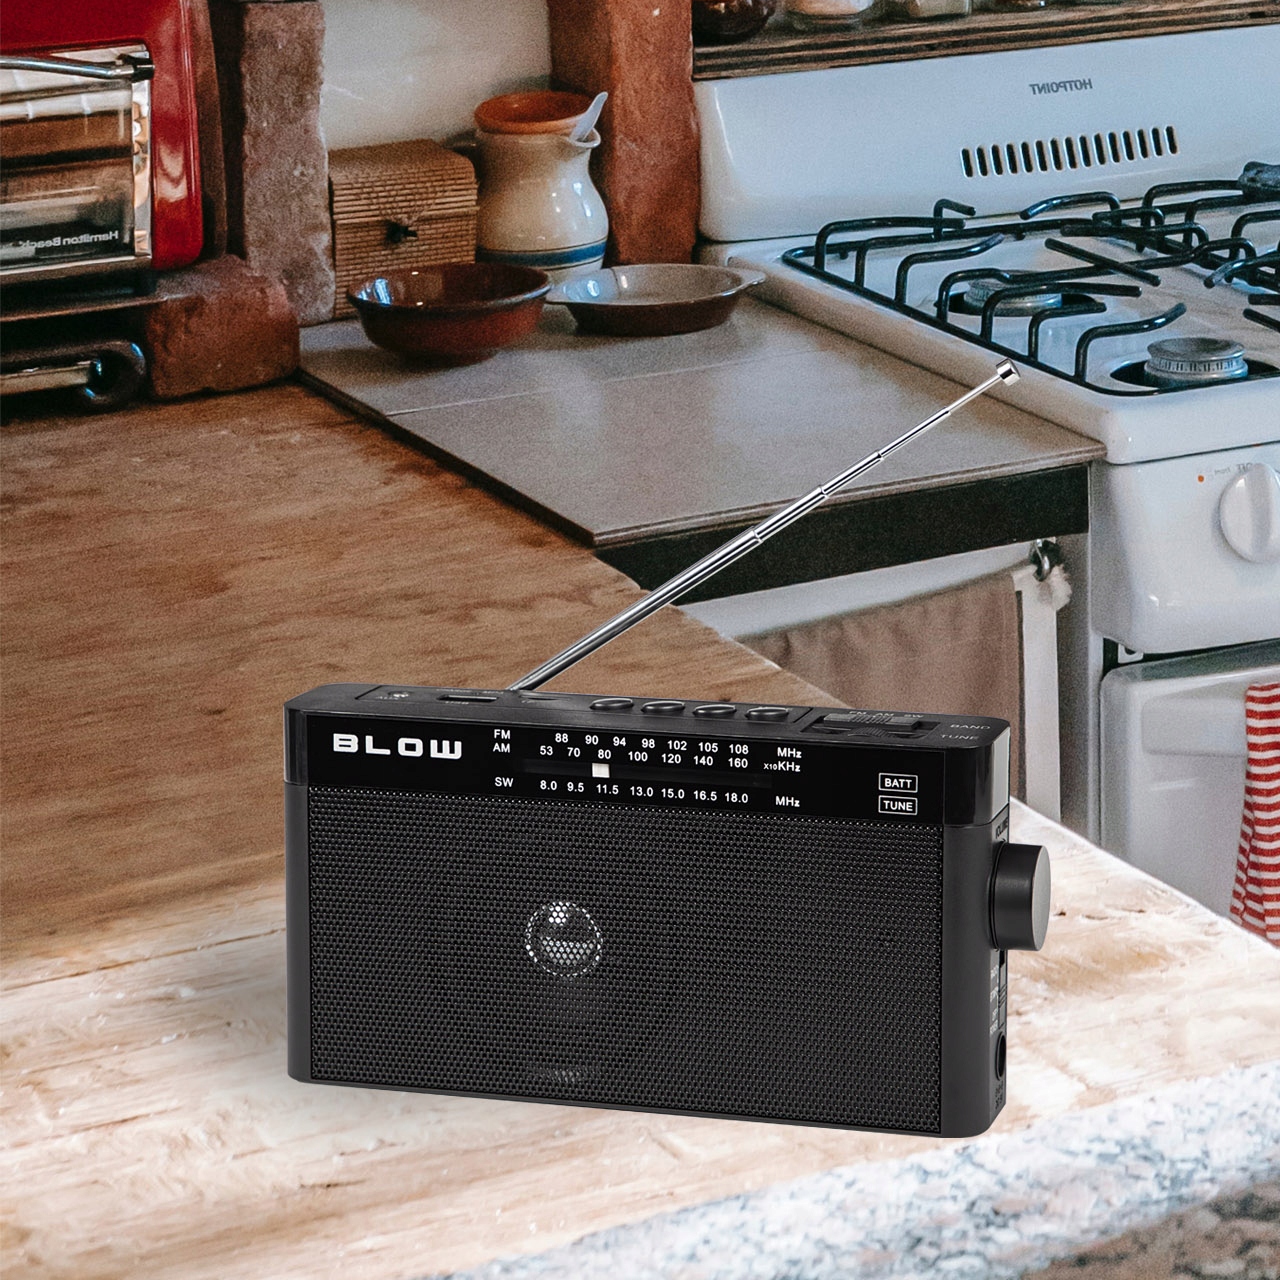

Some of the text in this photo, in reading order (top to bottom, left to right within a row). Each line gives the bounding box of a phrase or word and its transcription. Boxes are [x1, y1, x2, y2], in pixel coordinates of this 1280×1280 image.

[333, 733, 463, 760] BLOW
[492, 742, 511, 753] AM
[539, 745, 554, 756] 53
[567, 747, 581, 758] 70
[597, 749, 612, 760] 80
[627, 751, 648, 762] 100
[661, 753, 682, 764] 120
[693, 755, 714, 766] 140
[727, 757, 749, 769] 160
[493, 729, 802, 759] FM 88 90 94 98 102 105 108 MHz
[494, 777, 800, 808] SW 8.0 9.5 11.5 13.0 15.0 16.5 18.0 MHz
[884, 777, 912, 789] BATT
[883, 800, 913, 811] TUNE
